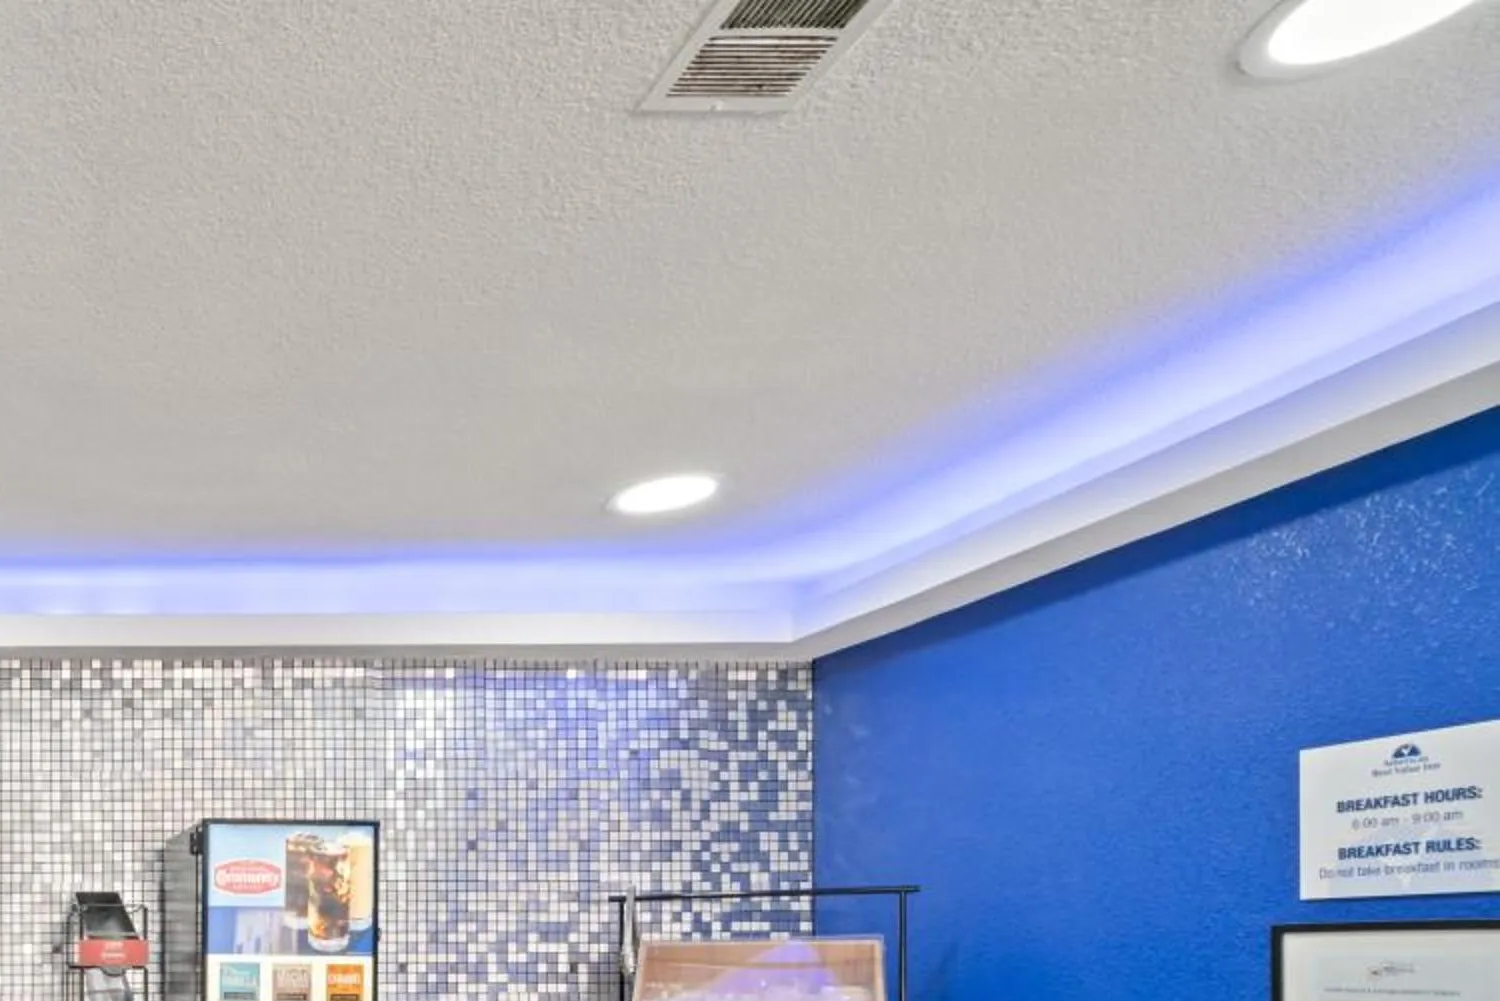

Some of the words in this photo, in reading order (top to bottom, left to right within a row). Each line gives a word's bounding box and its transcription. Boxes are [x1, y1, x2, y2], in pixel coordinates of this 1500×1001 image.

[1336, 792, 1419, 813] BREAKFAST
[1424, 785, 1484, 804] HOURS:
[1444, 810, 1463, 821] am
[1338, 841, 1421, 860] BREAKFAST
[1425, 836, 1483, 854] RULES:
[1319, 867, 1334, 880] Do
[1357, 864, 1381, 877] take
[1384, 861, 1441, 876] breakfast
[1444, 860, 1455, 871] in
